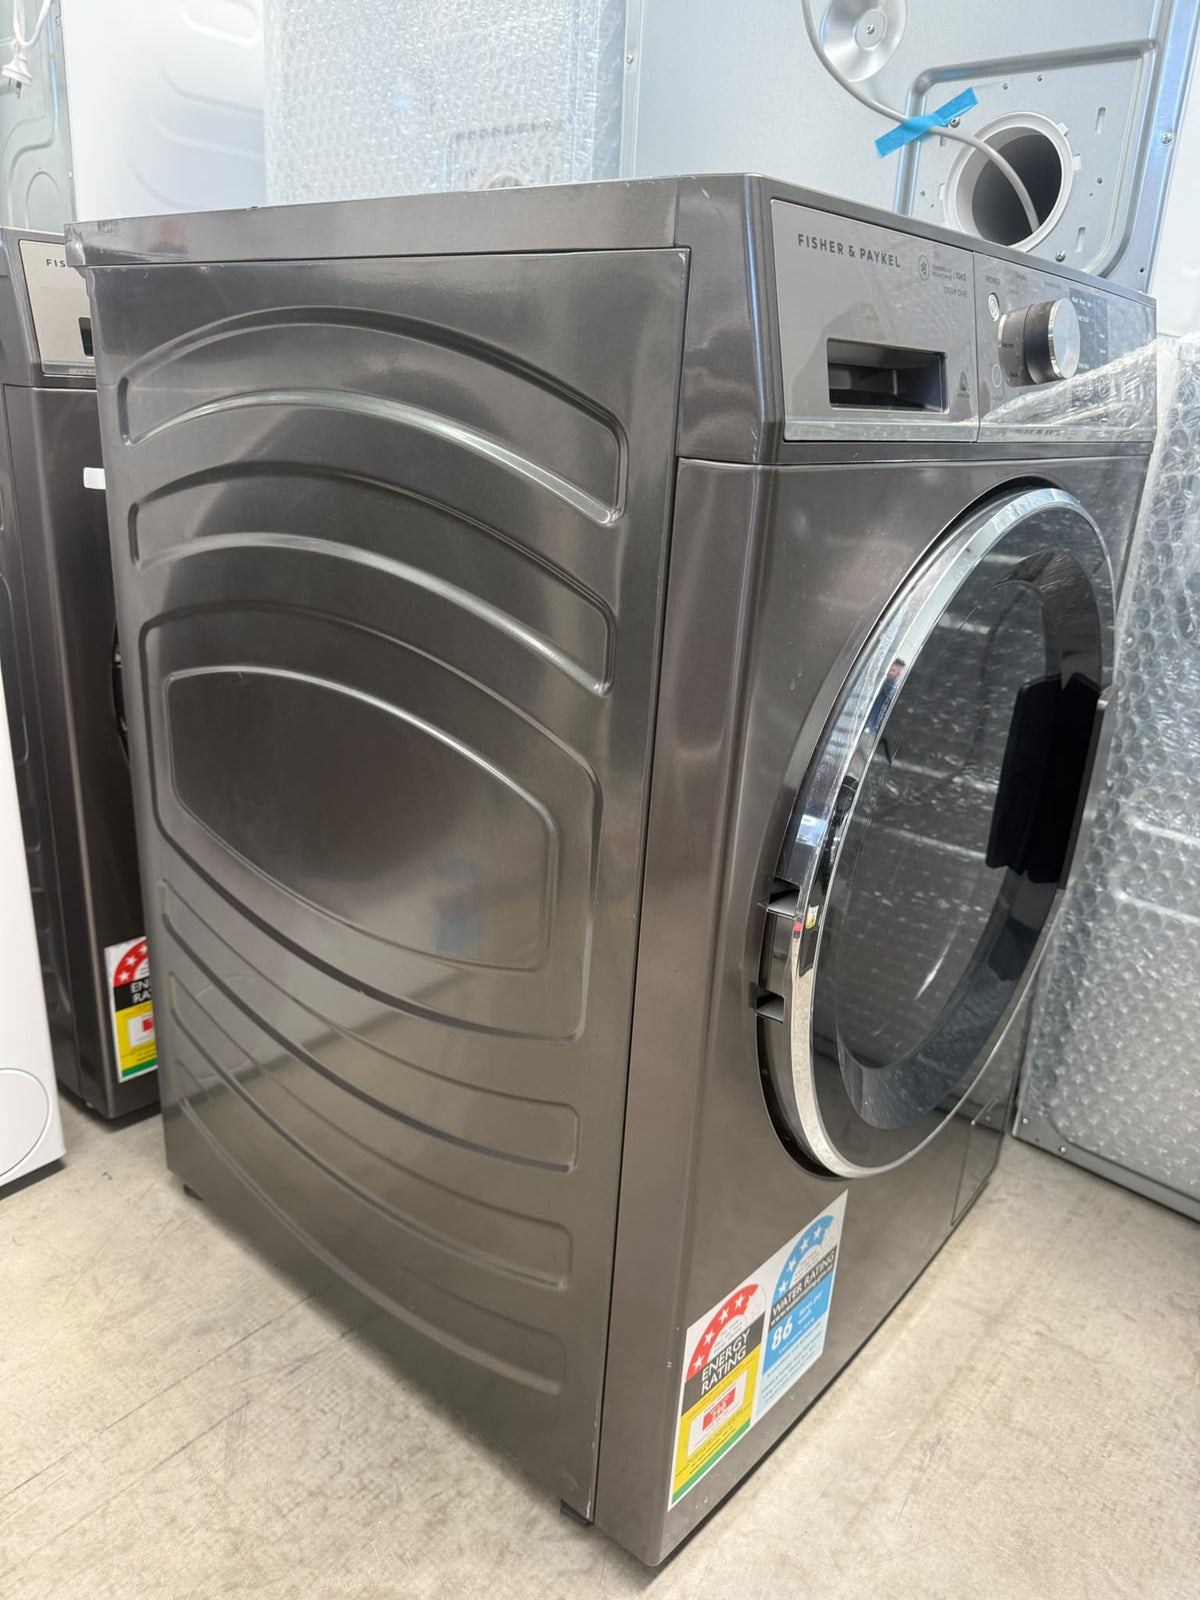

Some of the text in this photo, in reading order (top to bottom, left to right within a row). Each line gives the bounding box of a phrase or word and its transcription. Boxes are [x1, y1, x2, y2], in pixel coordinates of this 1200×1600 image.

[46, 259, 66, 268] FIS
[798, 233, 901, 268] FISHER & PAYKEL
[131, 978, 151, 993] EN
[133, 989, 152, 1004] RA
[772, 1281, 803, 1318] WATER
[771, 1314, 793, 1351] 86
[701, 1328, 751, 1382] ENERGY
[701, 1344, 747, 1396] RATING
